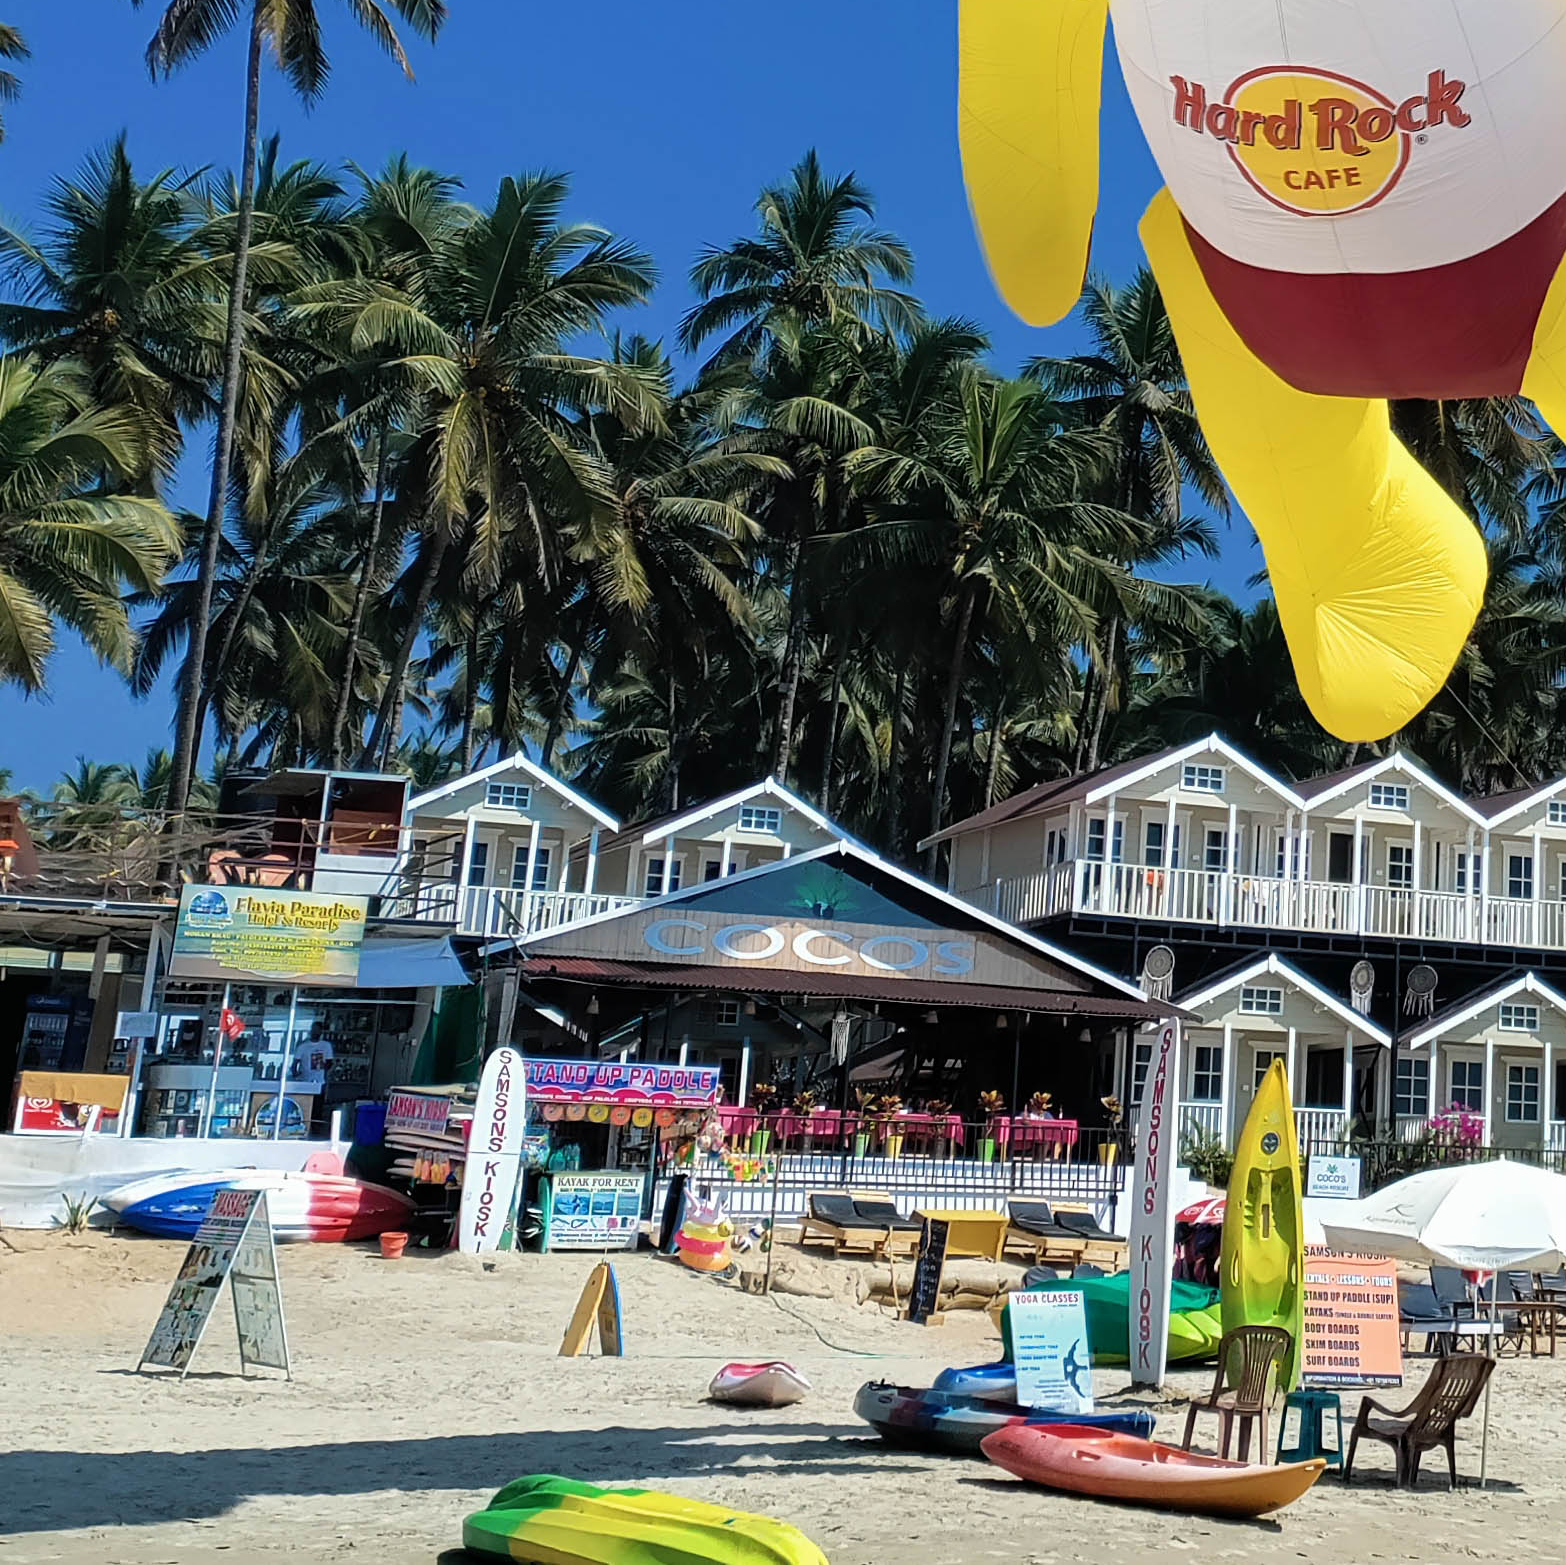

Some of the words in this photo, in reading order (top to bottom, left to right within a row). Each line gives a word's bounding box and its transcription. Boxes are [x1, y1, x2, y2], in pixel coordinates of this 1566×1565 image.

[1169, 74, 1302, 151] Hard
[1308, 68, 1472, 157] Rock
[1283, 166, 1363, 191] CAFE
[235, 896, 285, 916] Flavia
[291, 901, 361, 921] Paradise
[247, 913, 279, 928] Hotel
[294, 916, 339, 933] Resorts
[643, 918, 975, 975] COCOS
[594, 1065, 624, 1086] UP
[628, 1067, 713, 1090] PADDLE
[488, 1050, 513, 1153] SAMSON'S
[1143, 1028, 1173, 1216] SAMSON'S
[557, 1177, 590, 1187] KAYAK
[592, 1177, 612, 1187] FOR
[614, 1178, 641, 1187] RENT
[473, 1161, 501, 1237] KIOSK
[1303, 1245, 1353, 1259] SAMSONS
[1336, 1274, 1365, 1286] LESSONS
[1371, 1275, 1394, 1287] TOURS
[1015, 1295, 1039, 1305] YOGA
[1041, 1293, 1079, 1304] CLASSES
[1303, 1291, 1329, 1302] STAND
[1330, 1292, 1340, 1302] UP
[1342, 1292, 1370, 1304] PADDLE
[1304, 1307, 1334, 1318] KAYAKS
[1304, 1322, 1325, 1334] BODY
[1327, 1323, 1360, 1335] BOARDS
[1305, 1338, 1326, 1350] SKIM
[1327, 1339, 1360, 1351] BOARDS
[1306, 1355, 1326, 1366] SURF
[1327, 1356, 1360, 1367] BOARDS
